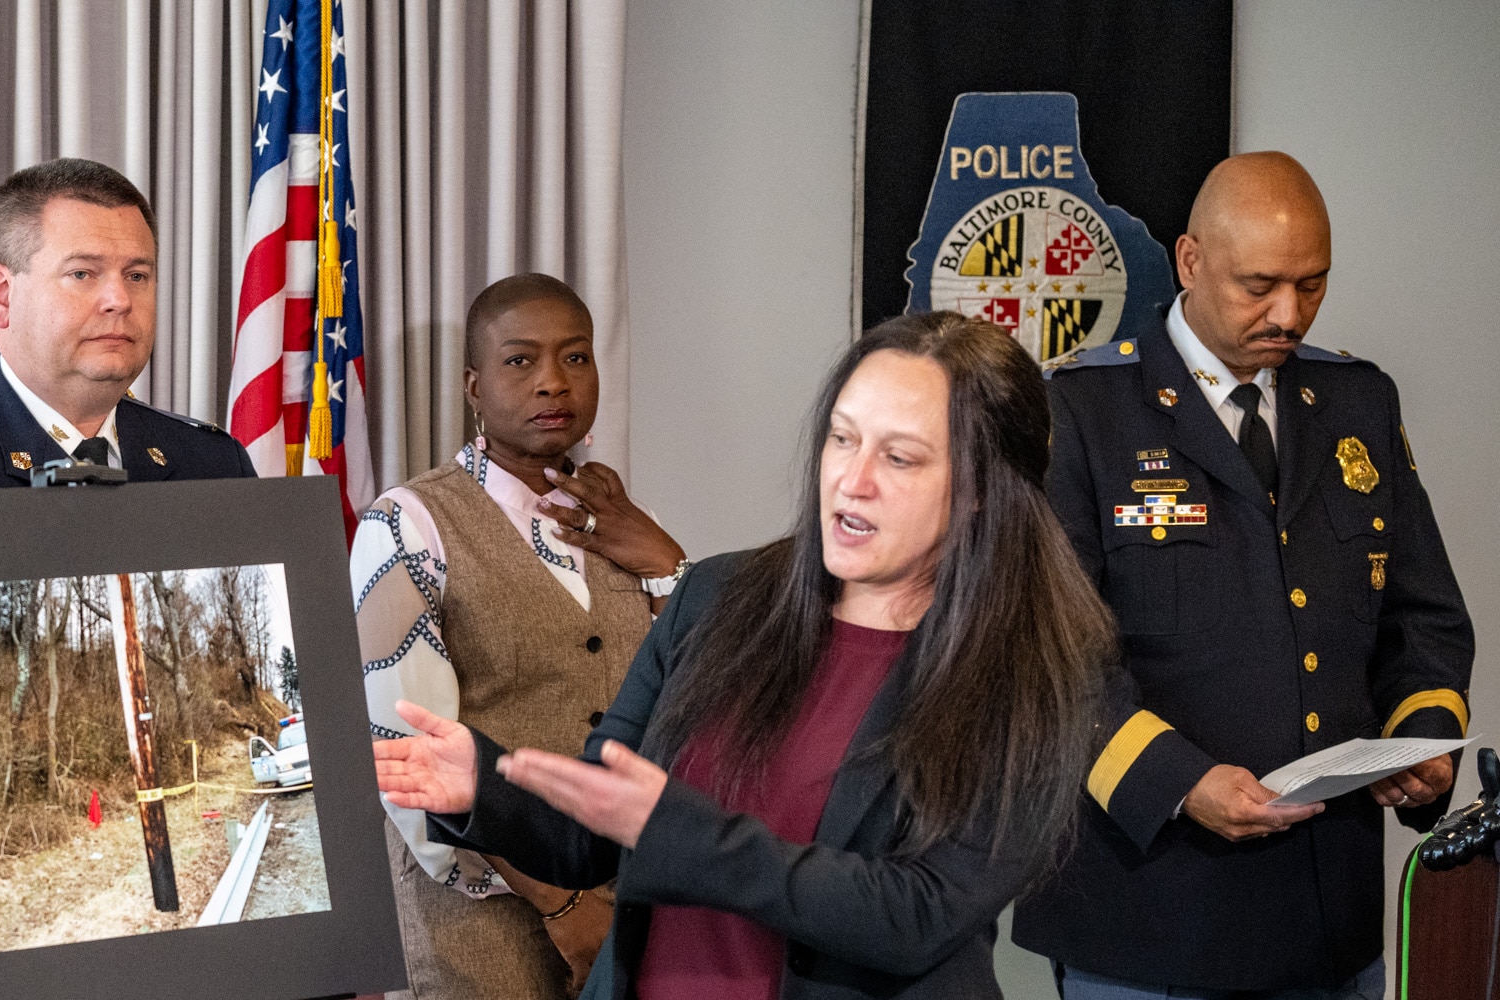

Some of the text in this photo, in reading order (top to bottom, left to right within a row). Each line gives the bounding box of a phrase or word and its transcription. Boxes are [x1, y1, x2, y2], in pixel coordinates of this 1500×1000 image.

[950, 144, 1075, 180] POLICE
[939, 190, 1122, 274] BALTIMORE COUNTY
